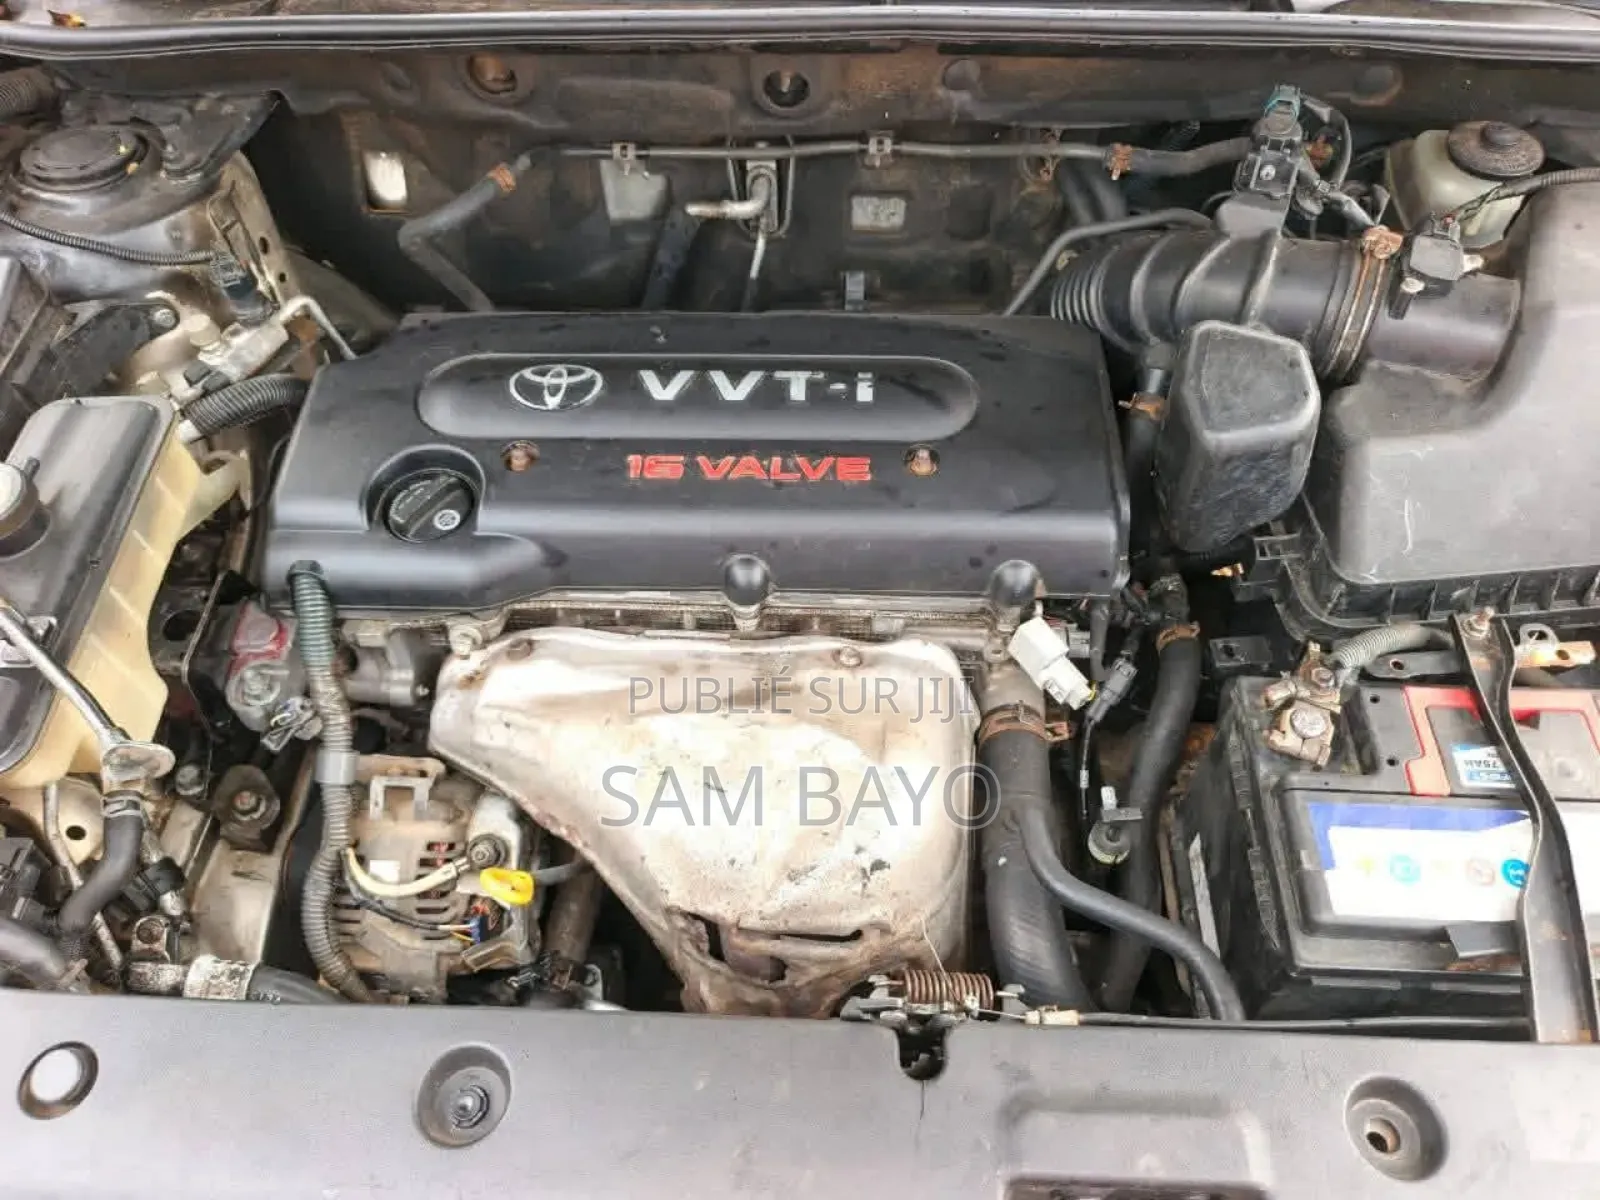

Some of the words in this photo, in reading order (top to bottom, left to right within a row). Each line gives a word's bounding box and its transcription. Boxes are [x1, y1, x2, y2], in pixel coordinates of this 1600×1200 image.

[638, 369, 874, 403] VVT-i
[626, 454, 685, 480] 16
[697, 455, 872, 481] VALVE
